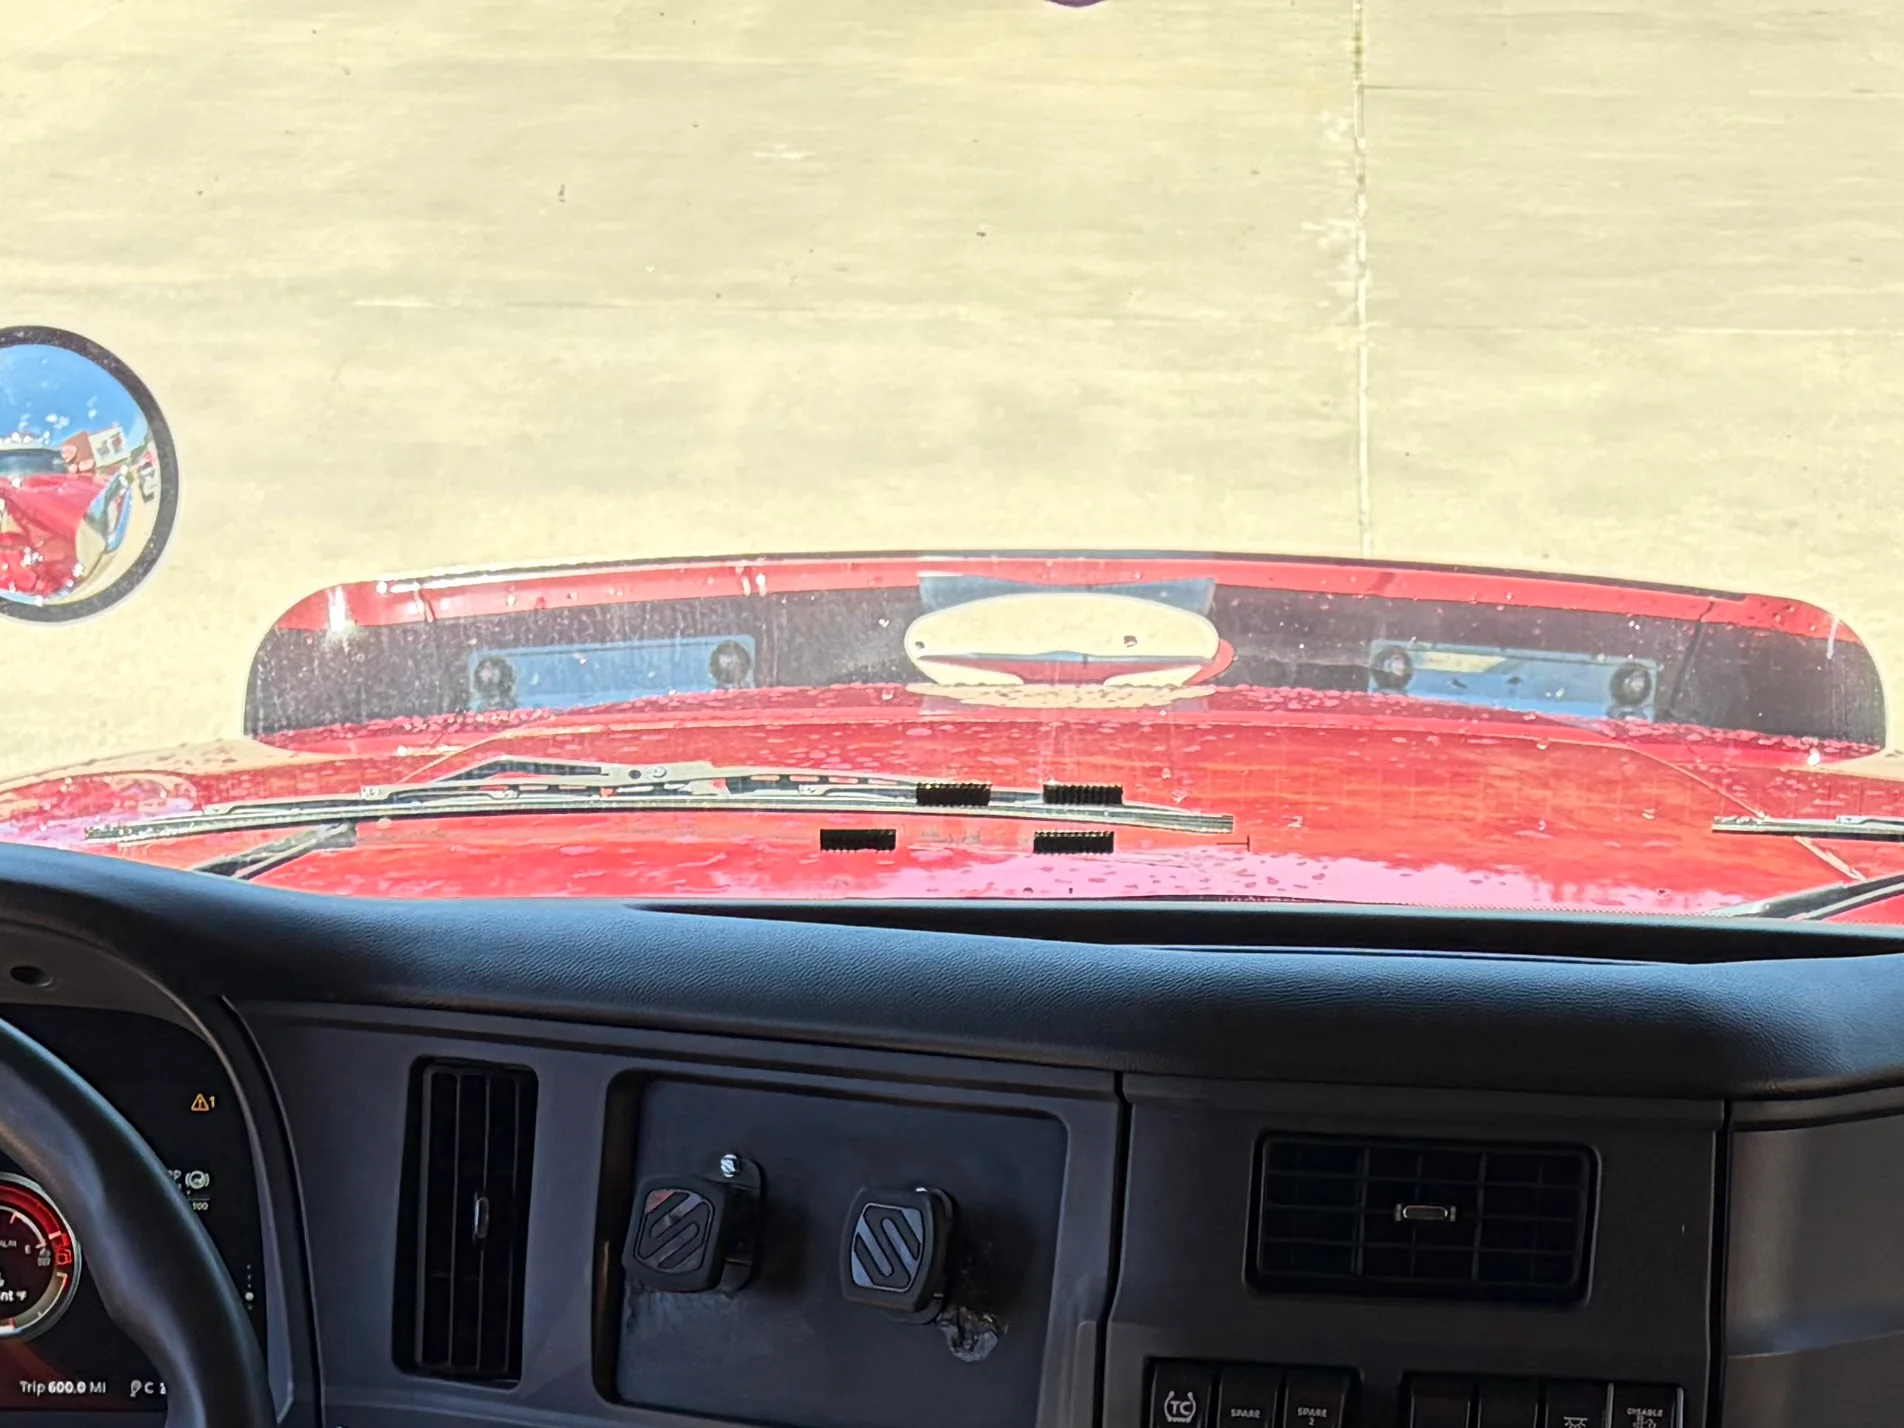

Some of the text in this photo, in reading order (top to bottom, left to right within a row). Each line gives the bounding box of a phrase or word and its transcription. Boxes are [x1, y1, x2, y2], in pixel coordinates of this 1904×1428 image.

[19, 1381, 106, 1396] Trip 600.0 MI
[1169, 1401, 1192, 1416] TC
[1230, 1408, 1261, 1419] SPARE
[1297, 1406, 1328, 1418] SPARE
[1308, 1417, 1315, 1426] 2
